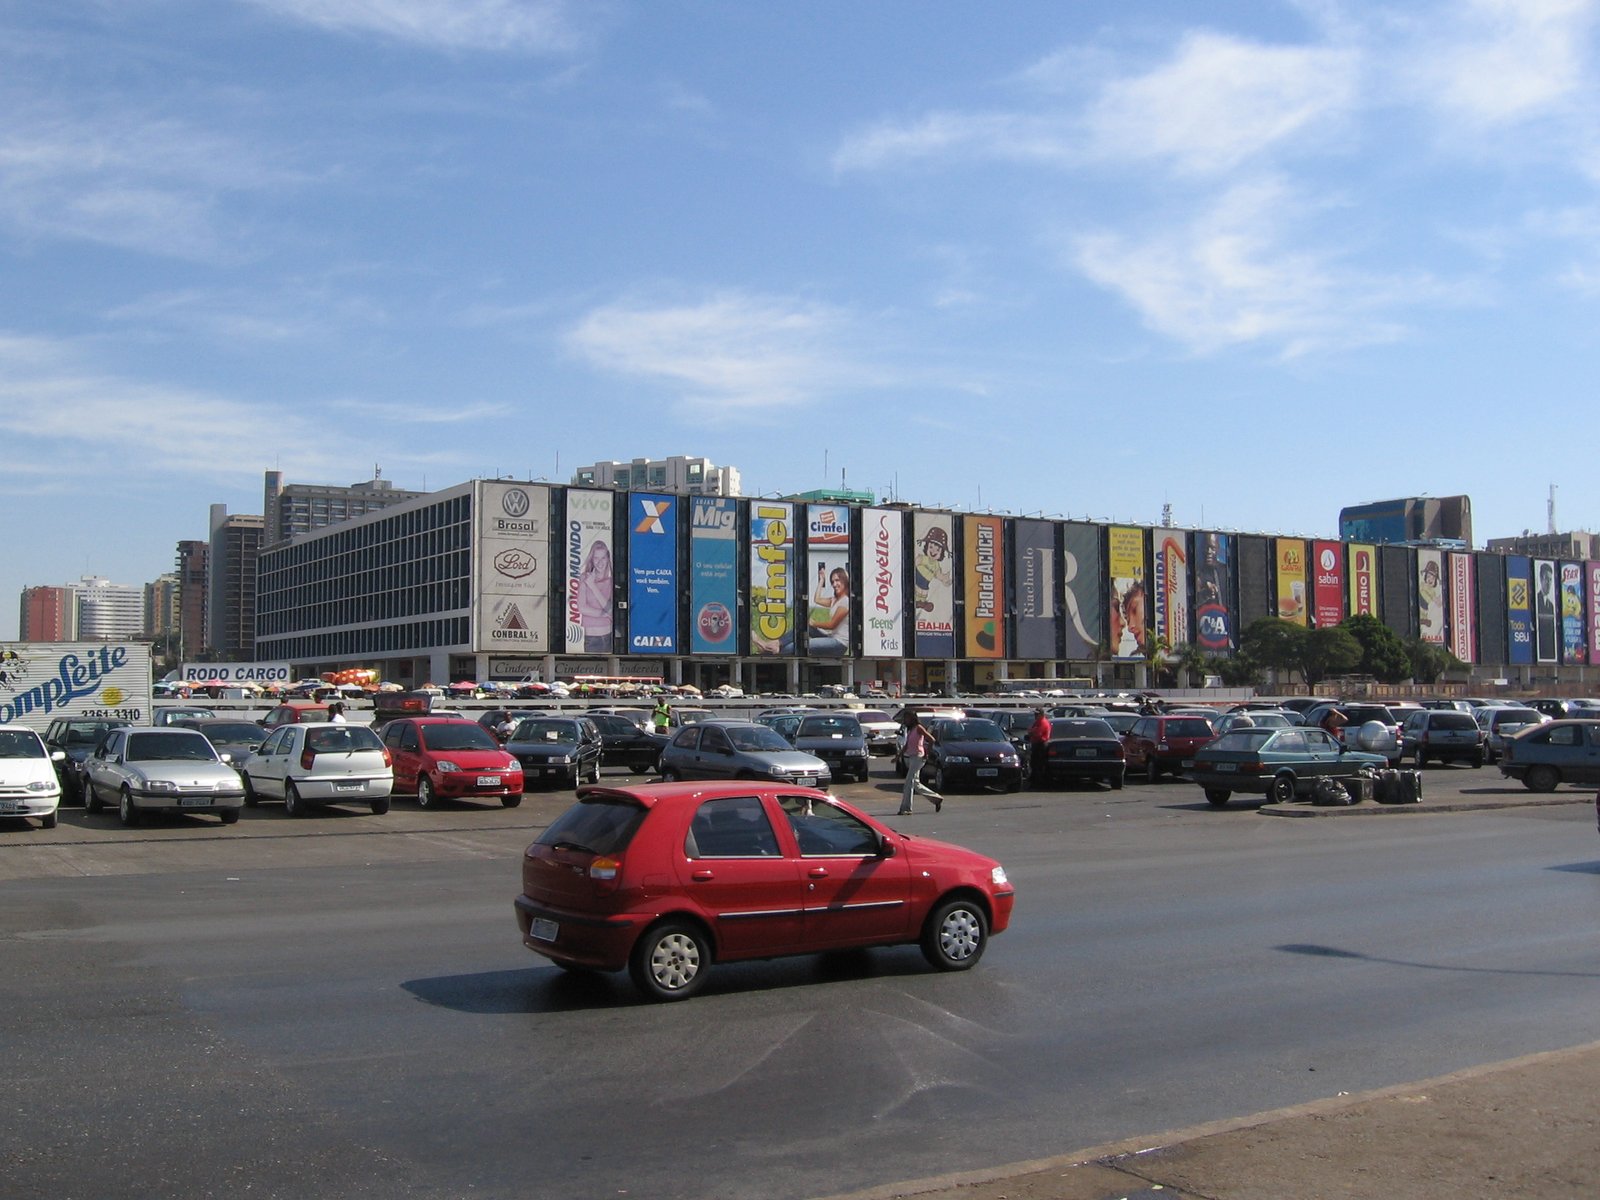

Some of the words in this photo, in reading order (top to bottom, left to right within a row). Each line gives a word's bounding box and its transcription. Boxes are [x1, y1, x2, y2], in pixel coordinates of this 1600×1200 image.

[498, 520, 534, 530] Brasal
[810, 521, 847, 533] Cimfel
[498, 553, 531, 569] Lord
[757, 505, 787, 640] Cimfel
[1318, 573, 1338, 584] sabin
[1023, 547, 1034, 618] Riachuelo
[1360, 575, 1369, 606] FRIO
[1458, 557, 1466, 626] AMERICANAS
[1156, 551, 1166, 643] TLANTIDA
[869, 617, 893, 630] Teens
[917, 621, 952, 630] BAHIA
[492, 630, 528, 639] CONBRAL
[1514, 631, 1530, 642] seu
[633, 635, 672, 647] CAIXA
[881, 639, 899, 651] Kids
[186, 668, 229, 680] RODO
[235, 667, 287, 680] CARGO
[555, 662, 603, 674] Cinderela
[619, 661, 659, 674] inderela
